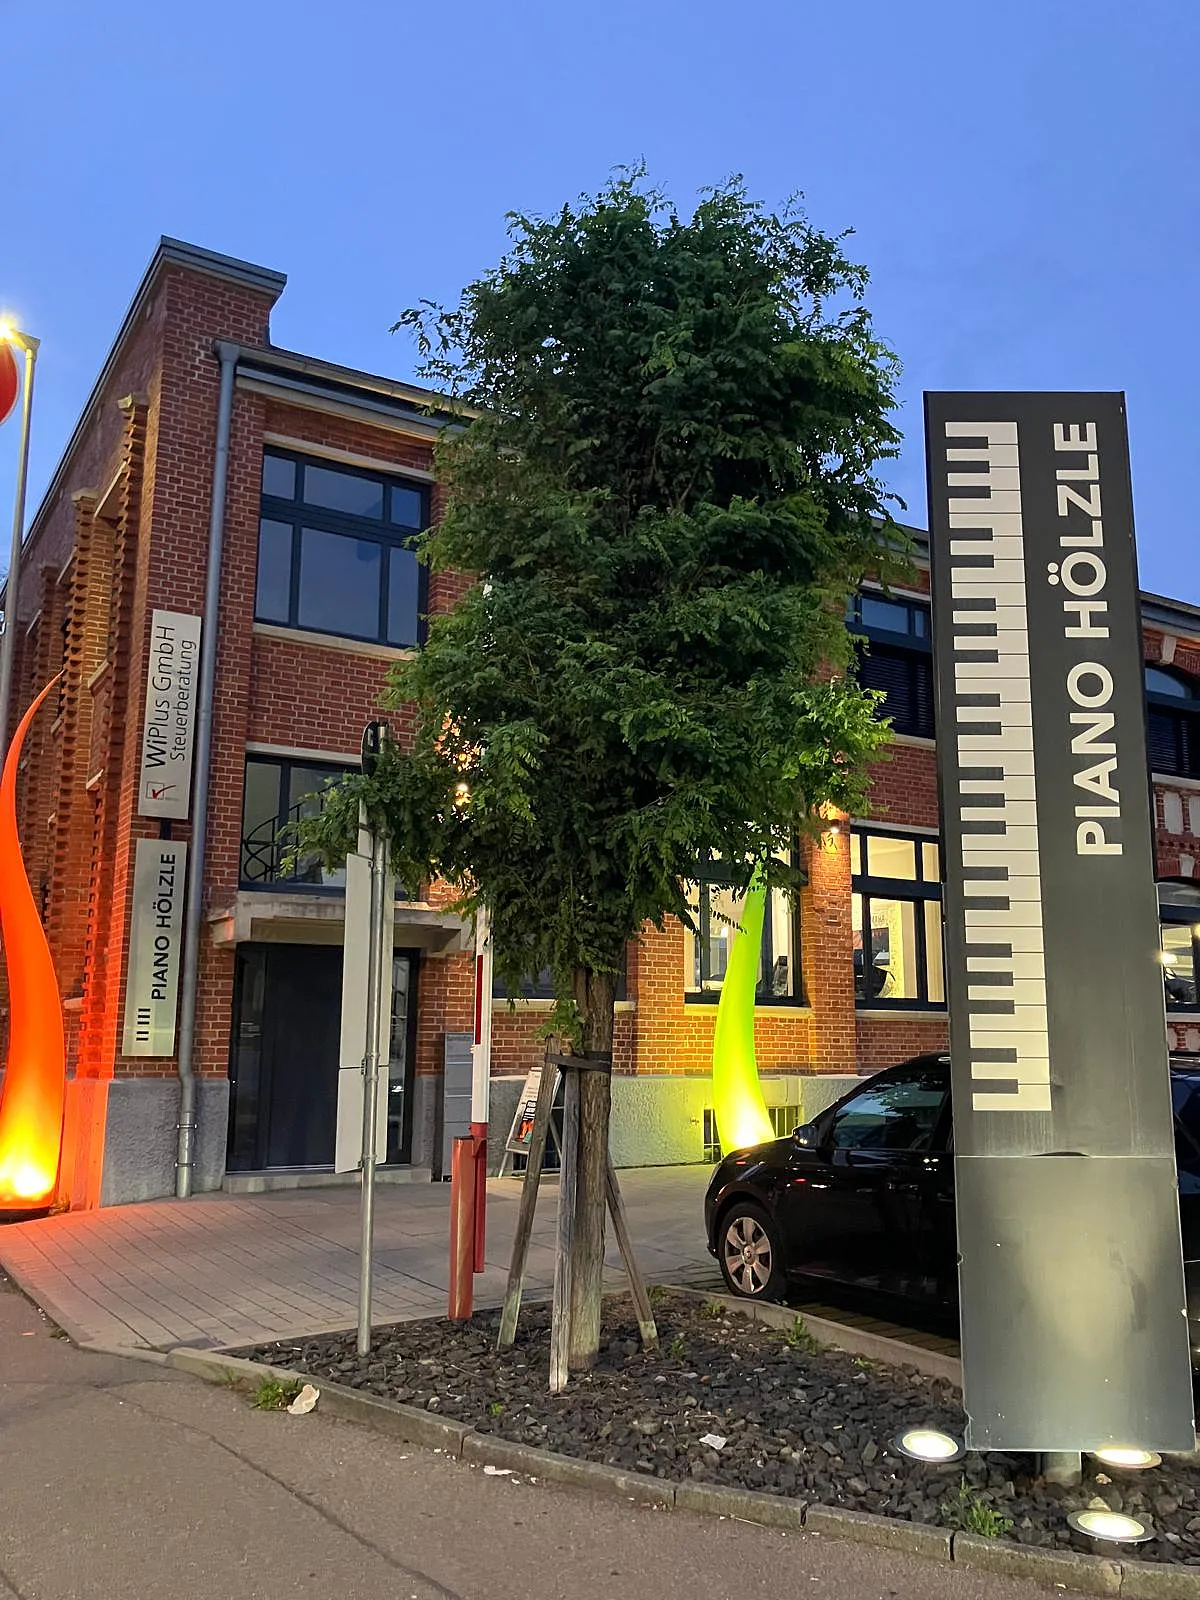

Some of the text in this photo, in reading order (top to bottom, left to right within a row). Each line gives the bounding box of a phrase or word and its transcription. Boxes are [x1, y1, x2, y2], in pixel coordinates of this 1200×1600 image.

[145, 625, 175, 768] WiPlus GmbH
[170, 639, 196, 761] Steuerberatung
[1047, 422, 1123, 857] PIANO HÖLZLE
[151, 853, 176, 1000] PIANO HÖLZLE
